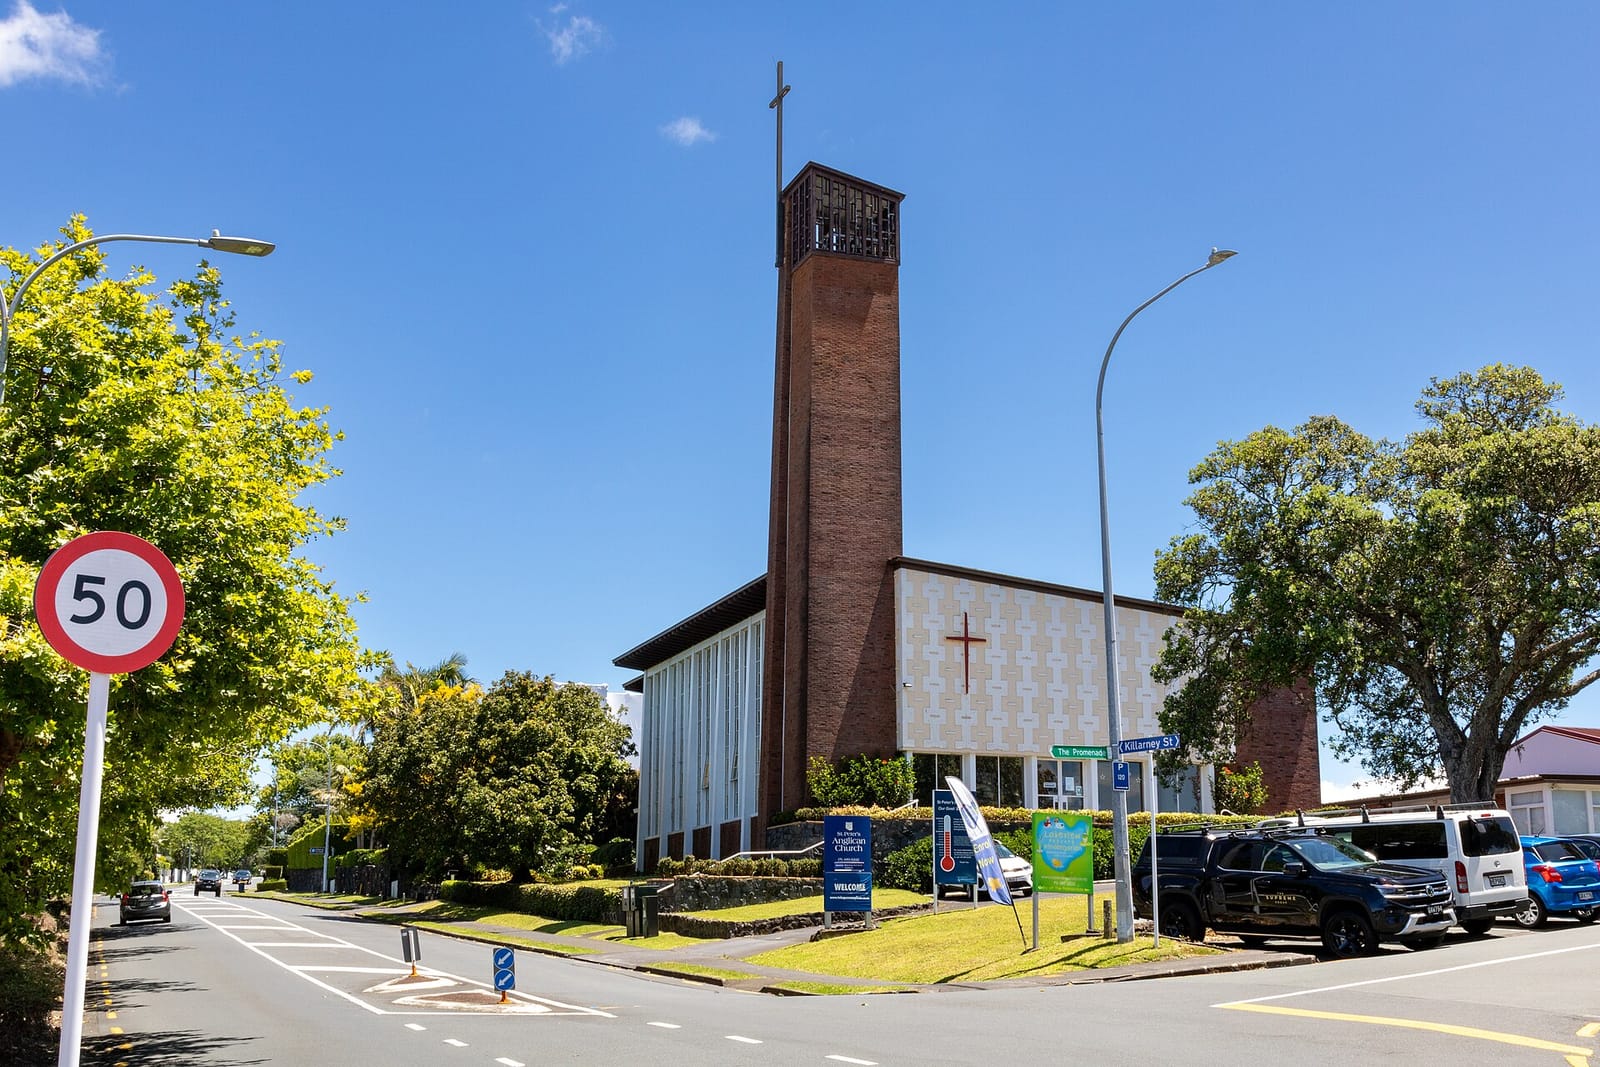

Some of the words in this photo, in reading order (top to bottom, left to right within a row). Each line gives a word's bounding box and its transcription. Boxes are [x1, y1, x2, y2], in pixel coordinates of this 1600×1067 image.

[69, 573, 152, 630] 50
[1124, 740, 1160, 752] Killarney
[1162, 737, 1174, 747] St
[1058, 748, 1070, 756] The
[1117, 763, 1124, 771] P
[832, 837, 866, 846] Anglican
[834, 844, 863, 852] Church
[973, 841, 990, 853] Enrol
[978, 857, 995, 868] Now
[834, 883, 866, 891] WELCOME
